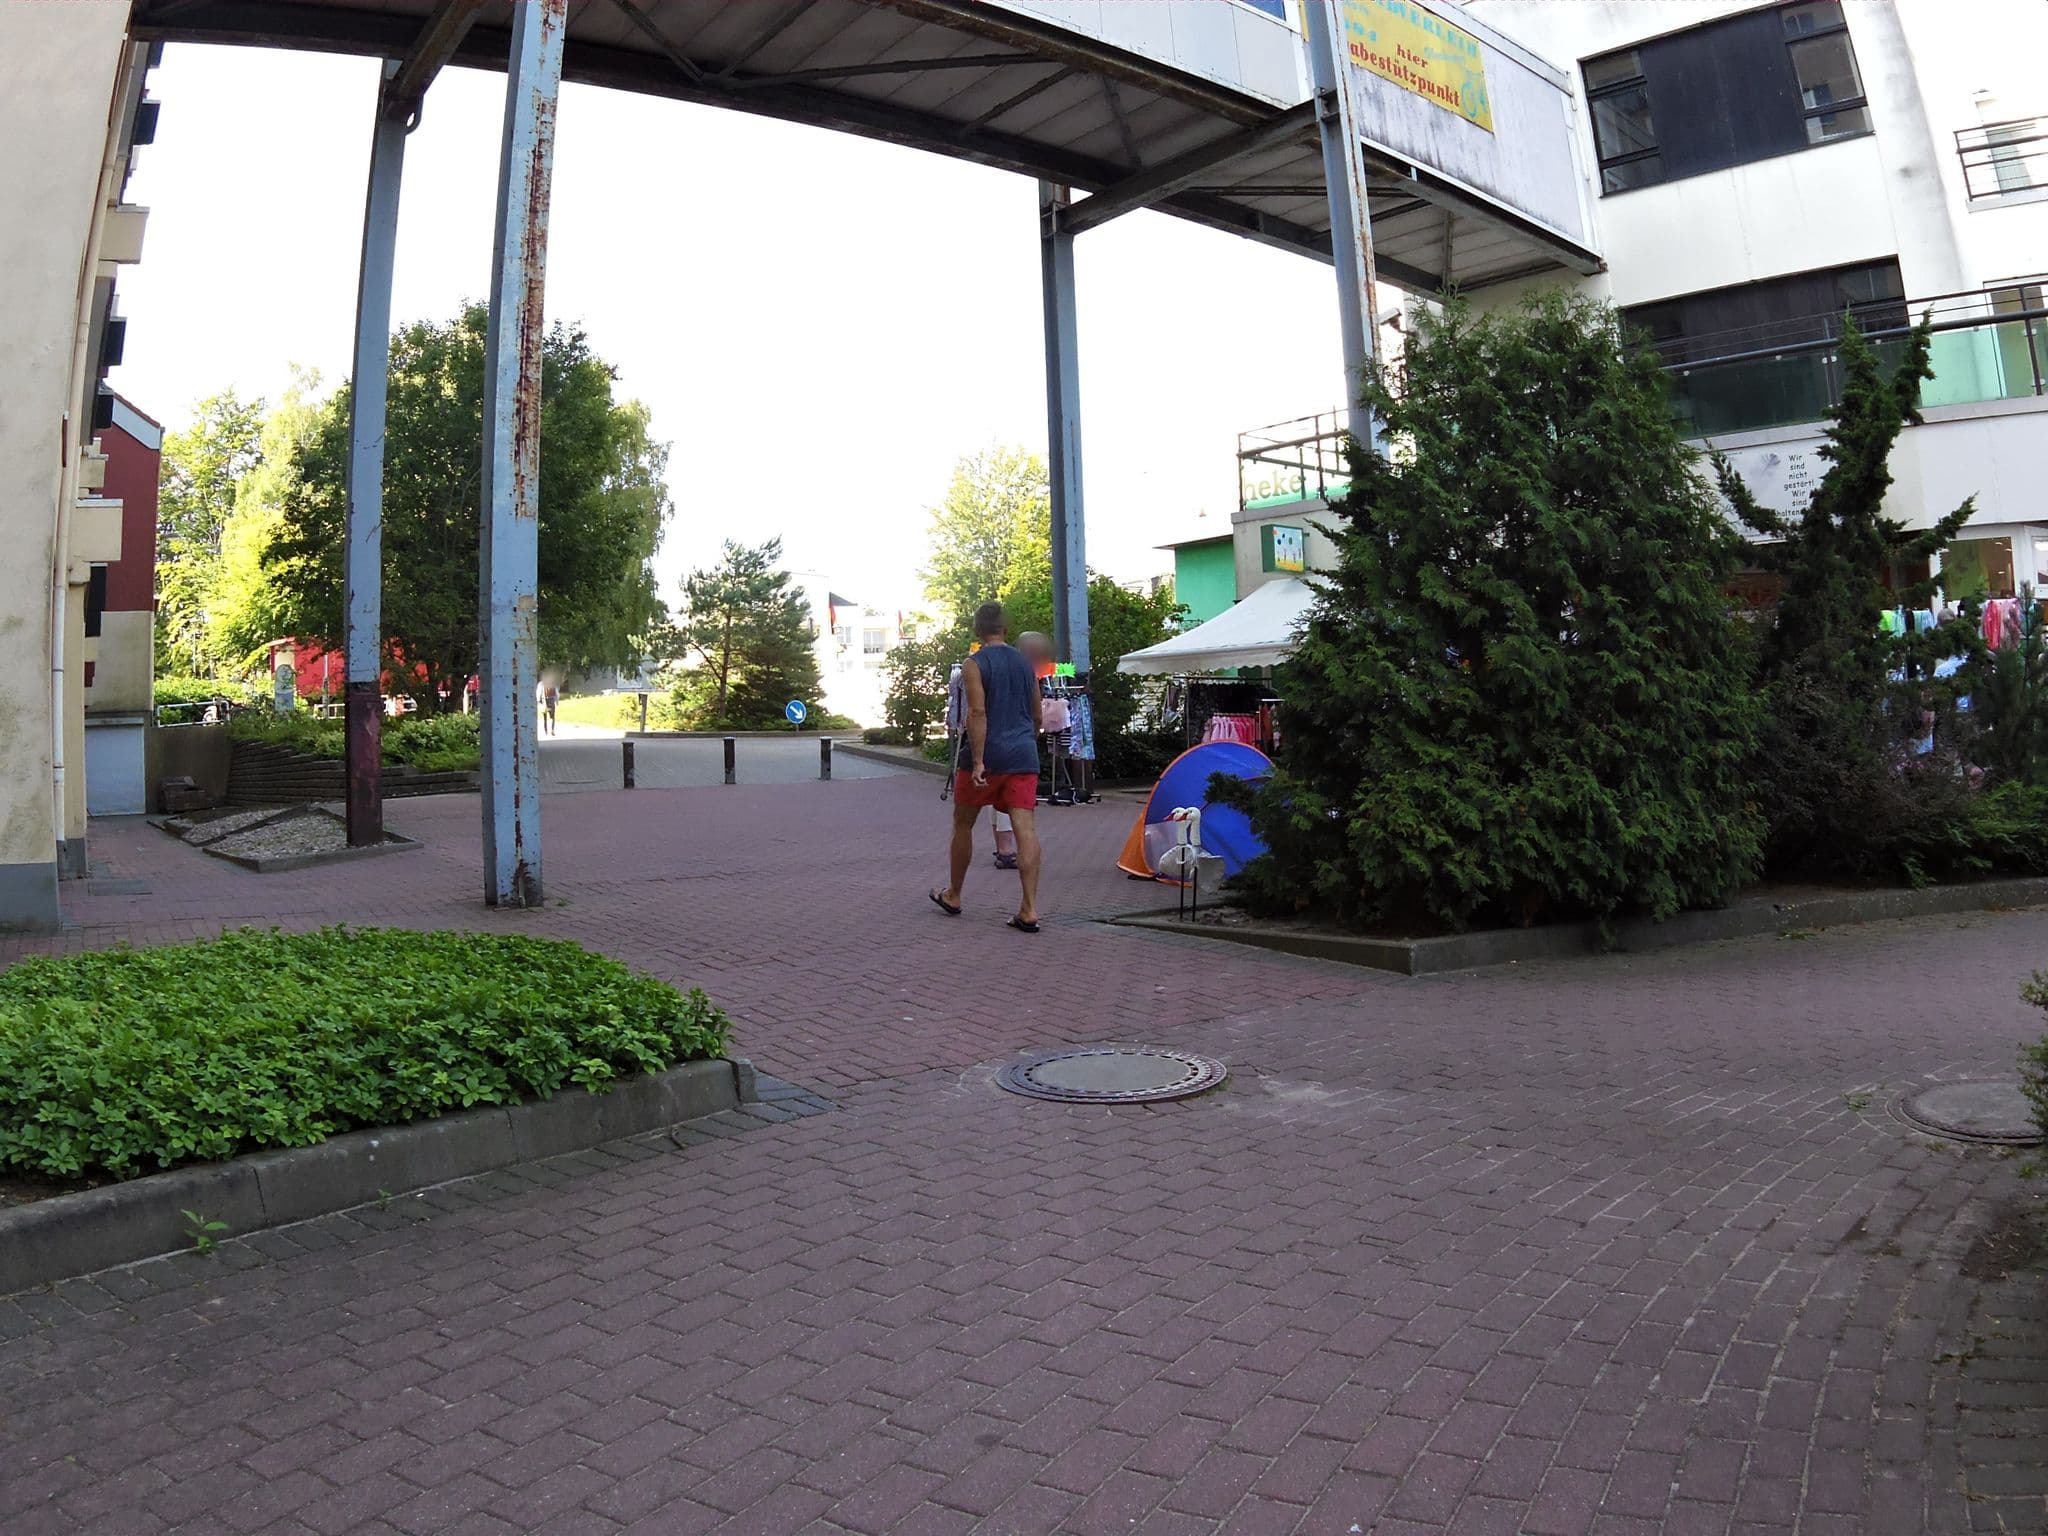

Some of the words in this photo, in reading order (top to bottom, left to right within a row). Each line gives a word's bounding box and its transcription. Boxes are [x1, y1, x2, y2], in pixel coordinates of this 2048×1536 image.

[1396, 44, 1429, 69] hier
[1788, 454, 1802, 462] Wir
[1790, 462, 1805, 471] sind
[1788, 471, 1808, 480] nicht
[1791, 498, 1808, 507] sind
